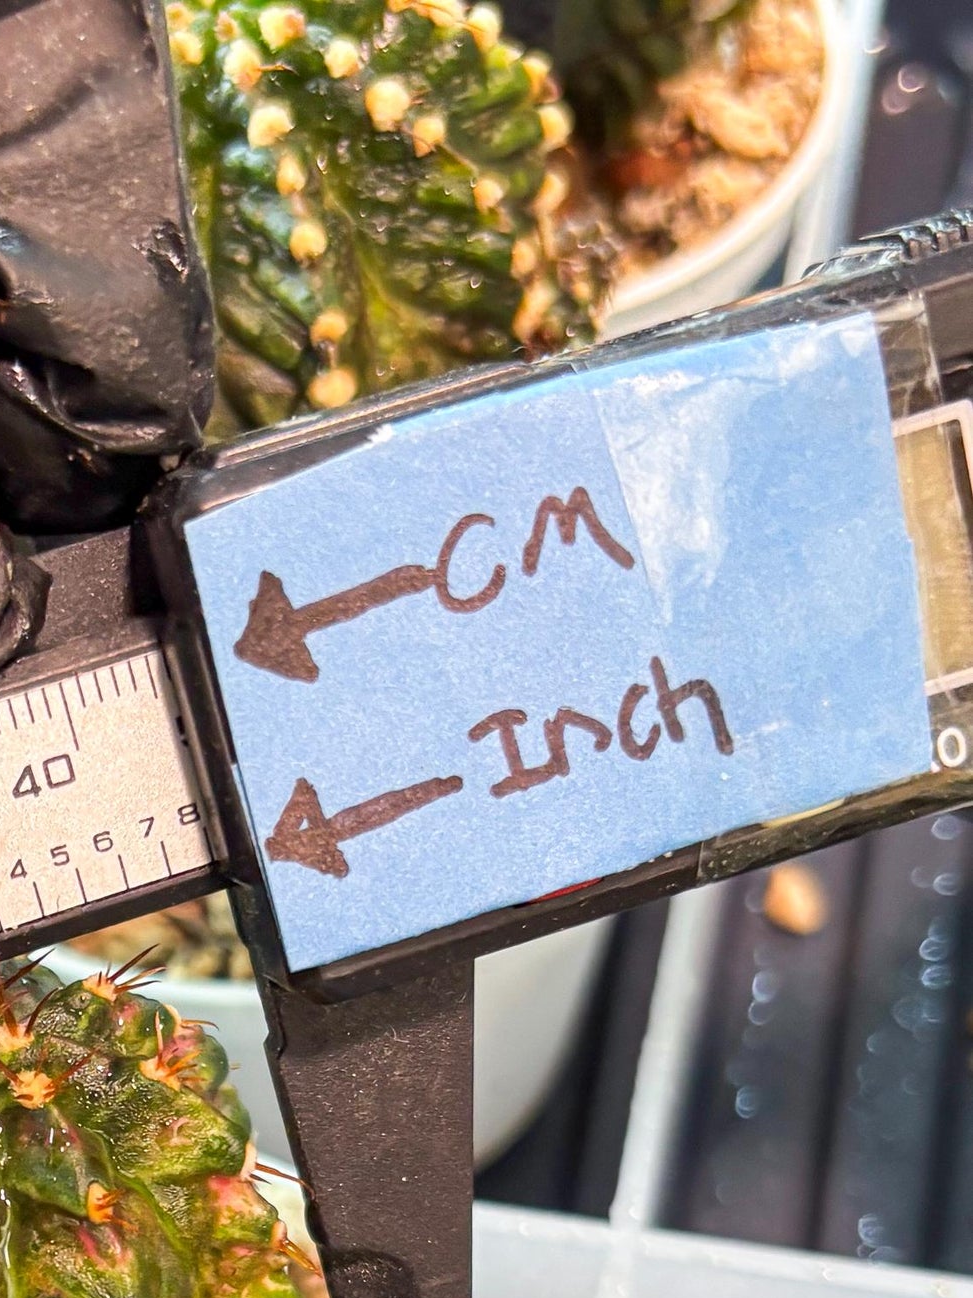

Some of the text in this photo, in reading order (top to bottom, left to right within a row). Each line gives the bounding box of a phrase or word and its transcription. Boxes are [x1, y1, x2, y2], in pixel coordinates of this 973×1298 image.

[468, 656, 733, 798] Inch
[12, 753, 76, 799] 40
[10, 858, 28, 879] 4
[50, 844, 70, 867] 5
[92, 830, 114, 853] 6
[138, 816, 155, 838] 7
[177, 802, 201, 826] 8
